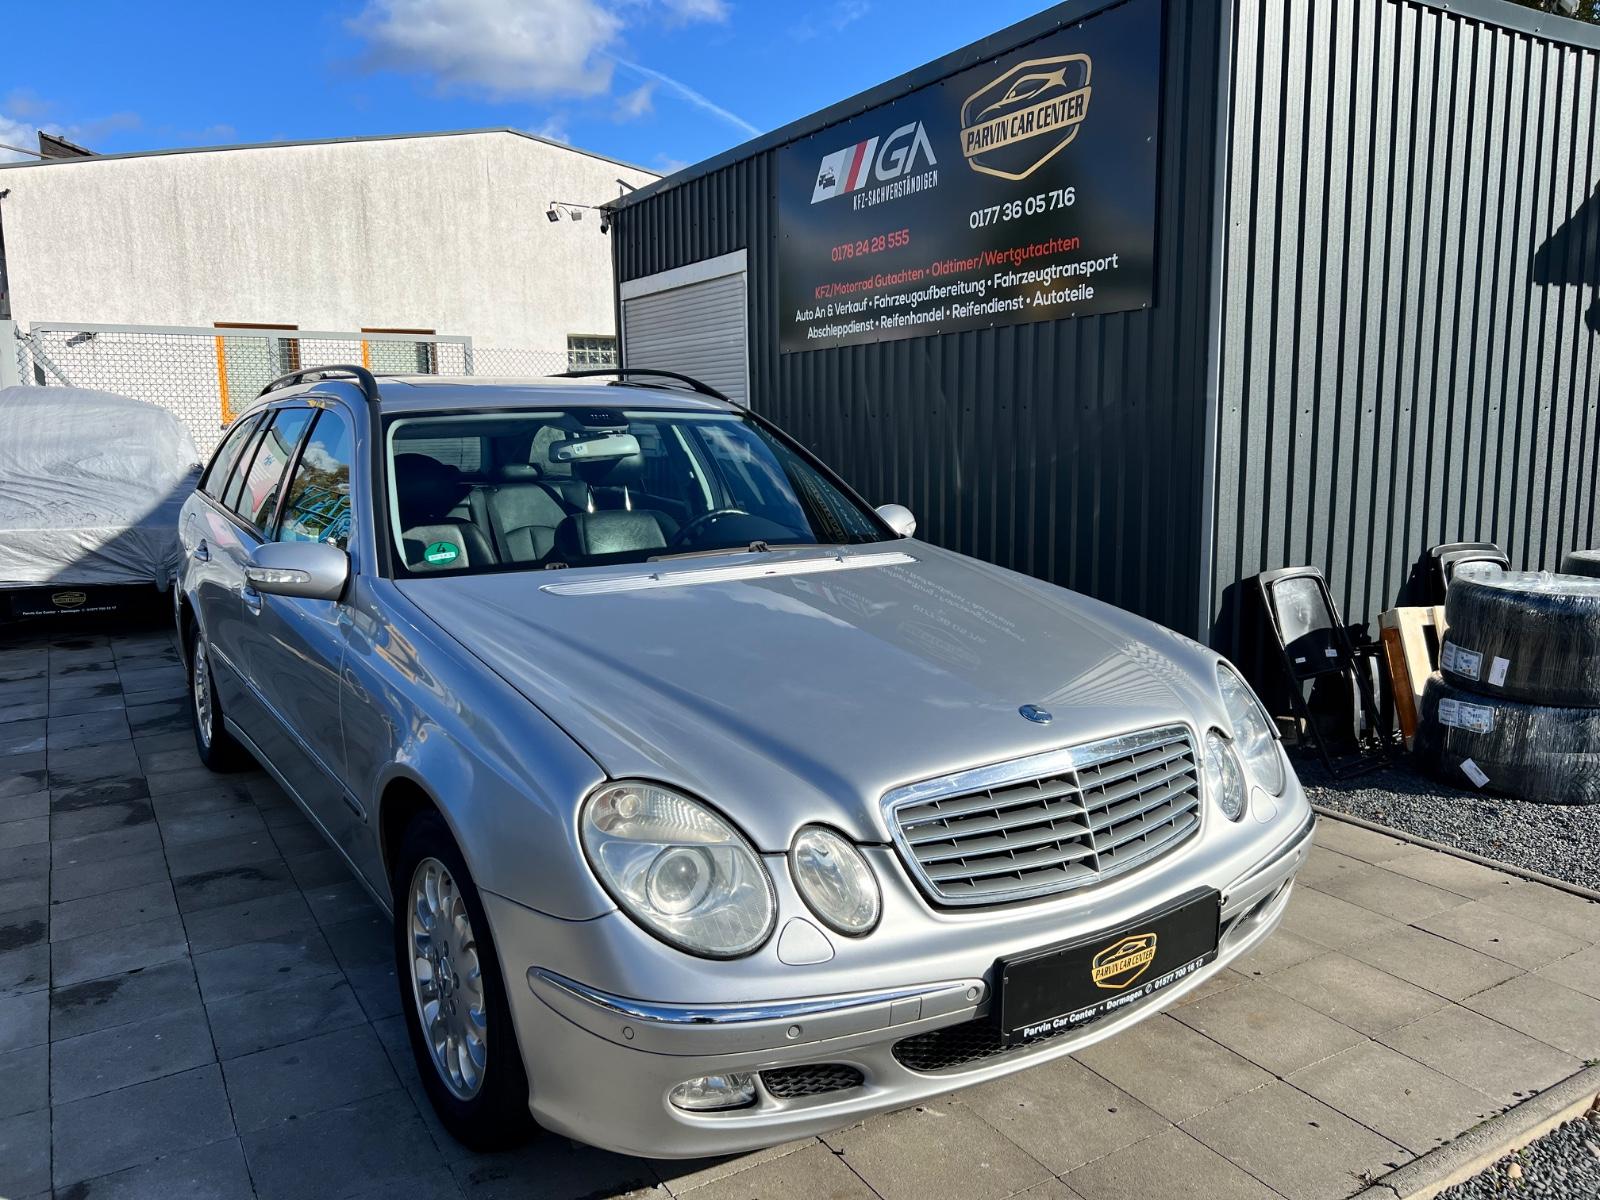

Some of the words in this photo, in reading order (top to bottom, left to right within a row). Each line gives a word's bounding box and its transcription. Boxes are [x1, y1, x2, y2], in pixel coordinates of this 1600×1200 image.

[966, 119, 1009, 152] PARVIN
[1010, 111, 1035, 138] CAR
[1036, 94, 1085, 129] CENTER
[853, 170, 938, 211] KFZ-SACHVERSTÄNDIGEN
[969, 206, 1000, 229] 0177
[1002, 200, 1022, 221] 36
[1025, 194, 1046, 215] 05
[1048, 186, 1076, 210] 716
[815, 277, 874, 299] KFZ/Motorrad
[875, 267, 924, 288] Gutachten
[932, 236, 1080, 277] Oldtimer/Wertgutachten
[831, 243, 854, 262] 0178
[855, 240, 870, 256] 24
[871, 235, 886, 252] 28
[888, 229, 910, 249] 555
[795, 310, 814, 322] Auto
[814, 306, 826, 319] An
[827, 303, 834, 316] &
[834, 298, 868, 316] Verkauf
[874, 279, 986, 309] Fahrzeugaufbereitung
[993, 253, 1119, 289] Fahrzeugtransport
[807, 317, 875, 340] Abschleppdienst
[880, 305, 945, 329] Reifenhandel
[952, 295, 1024, 319] Reifendienst
[1032, 284, 1094, 307] Autoteile
[1095, 962, 1119, 979] PARVIN
[1119, 957, 1132, 970] CAR
[1131, 948, 1154, 966] CENTER
[1023, 1022, 1051, 1038] Parvin
[1052, 1017, 1068, 1028] Car
[1069, 1007, 1097, 1023] Center
[1106, 989, 1143, 1010] Dormagen
